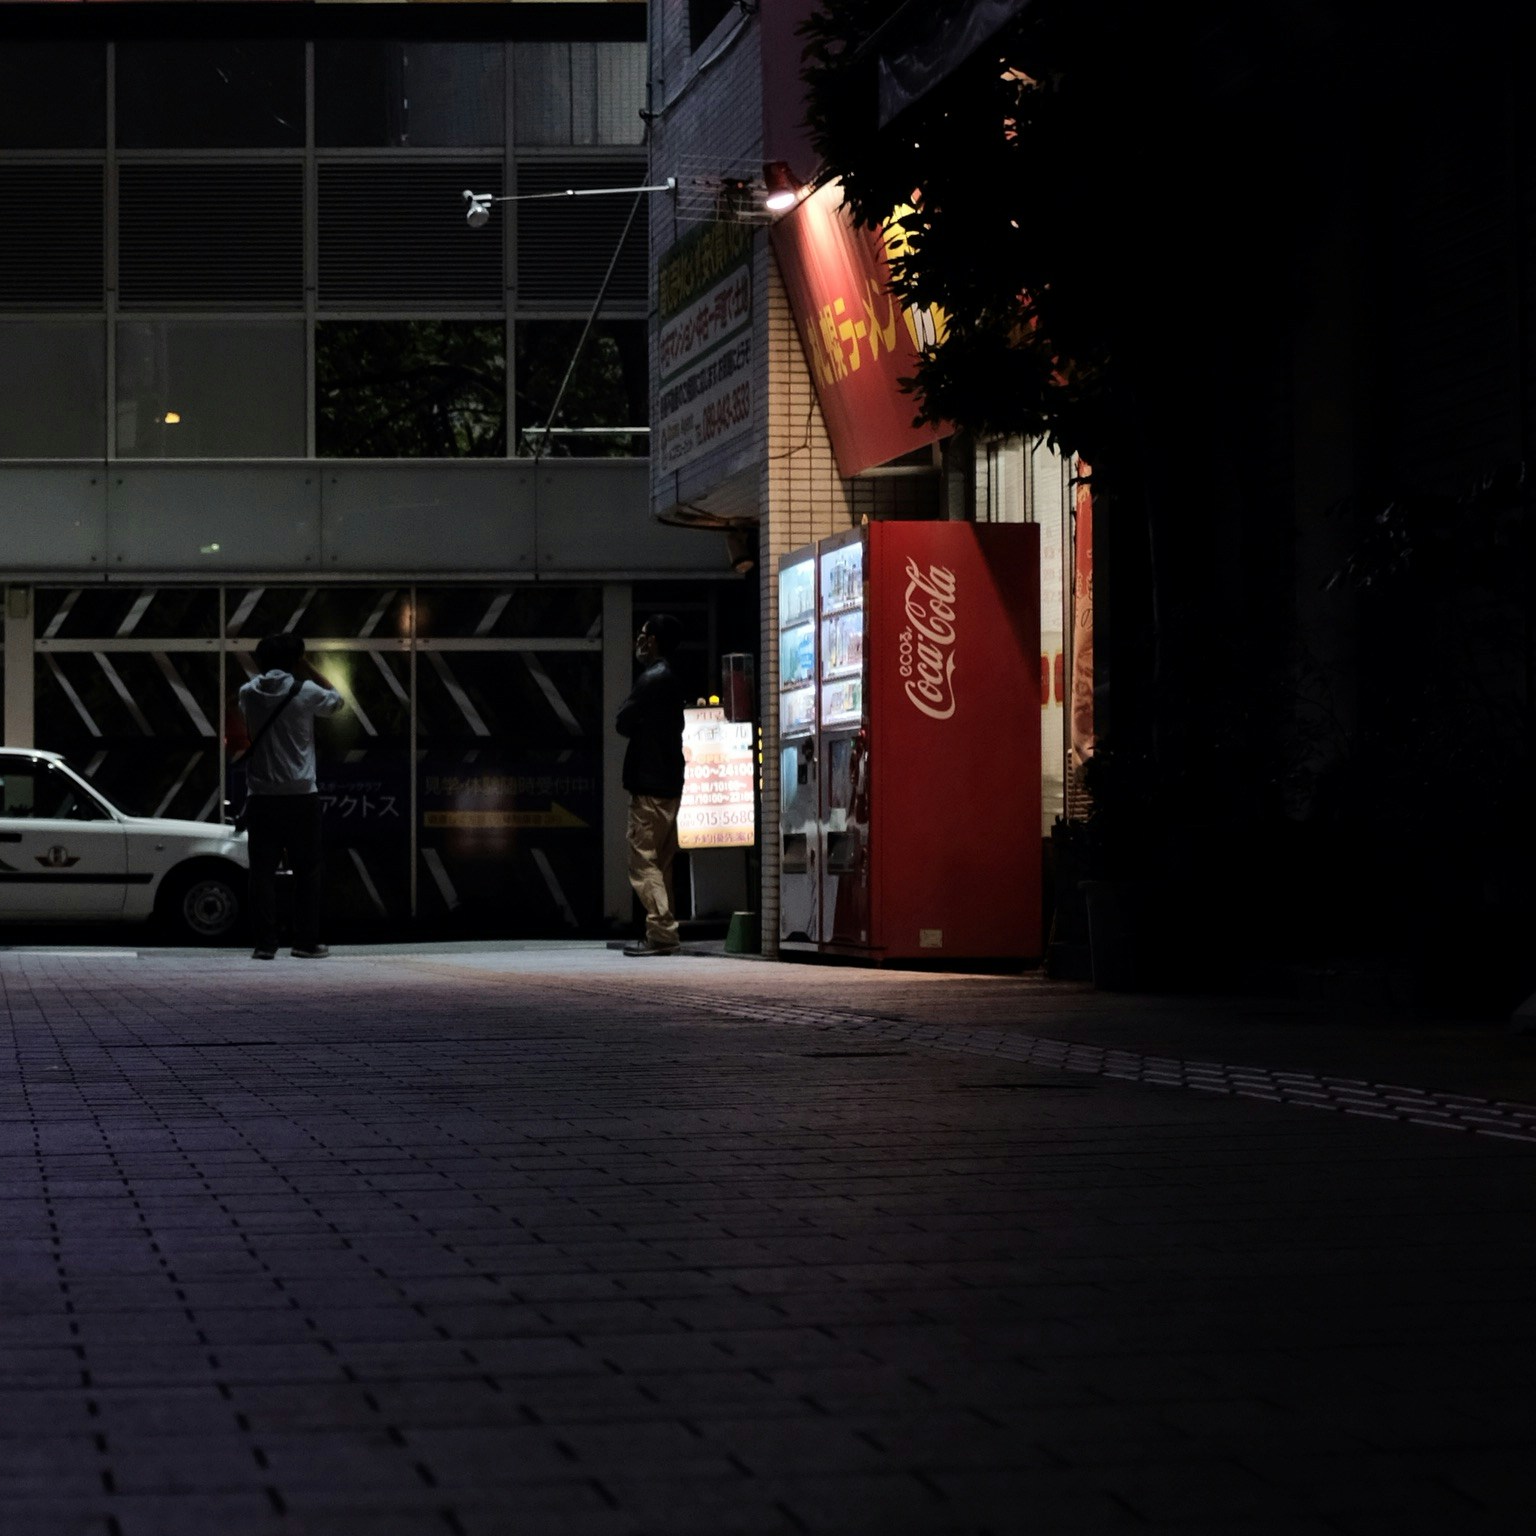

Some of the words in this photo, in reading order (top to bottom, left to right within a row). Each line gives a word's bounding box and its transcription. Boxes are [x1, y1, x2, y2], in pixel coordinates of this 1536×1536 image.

[904, 555, 956, 720] Coca-Cola
[319, 795, 400, 819] アクトス
